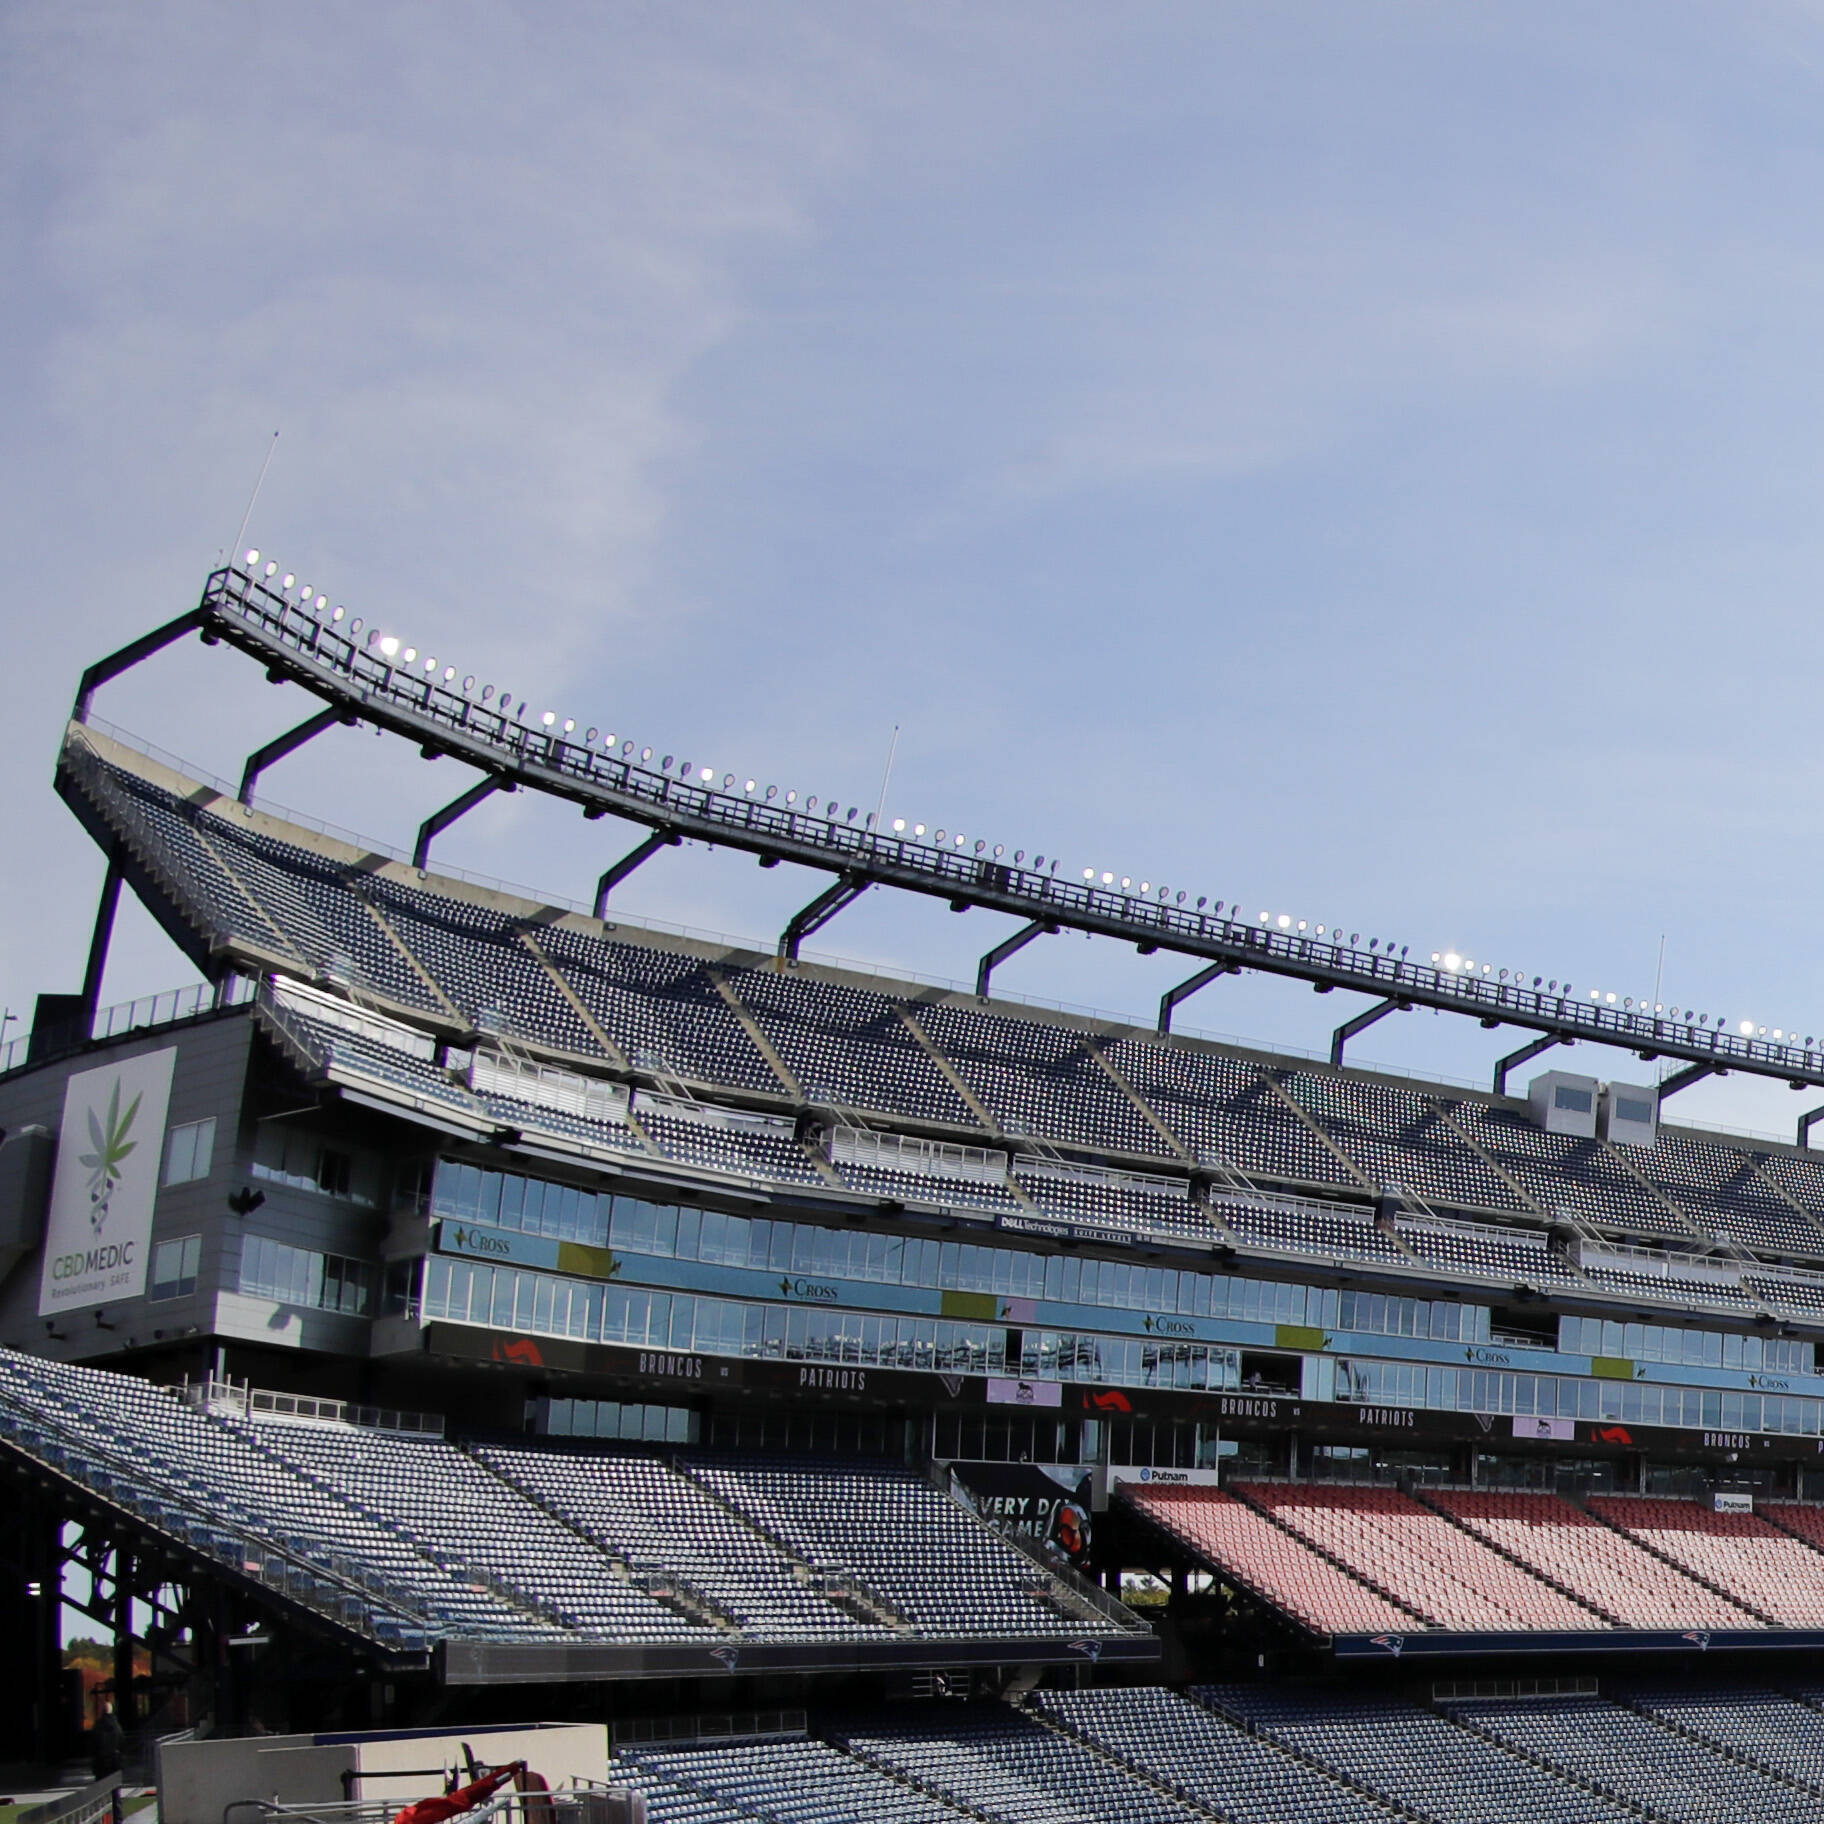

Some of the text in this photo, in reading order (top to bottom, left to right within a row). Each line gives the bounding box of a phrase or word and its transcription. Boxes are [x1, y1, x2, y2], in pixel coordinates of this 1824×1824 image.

[53, 1241, 134, 1280] CBDMEDIC
[639, 1352, 702, 1378] BRONCOS
[800, 1367, 866, 1391] PATRIOTS
[1221, 1398, 1277, 1418] BRONCOS
[1359, 1408, 1415, 1427] PATRIOTS
[1704, 1433, 1751, 1449] BRONCOS
[1151, 1469, 1188, 1483] Putnam
